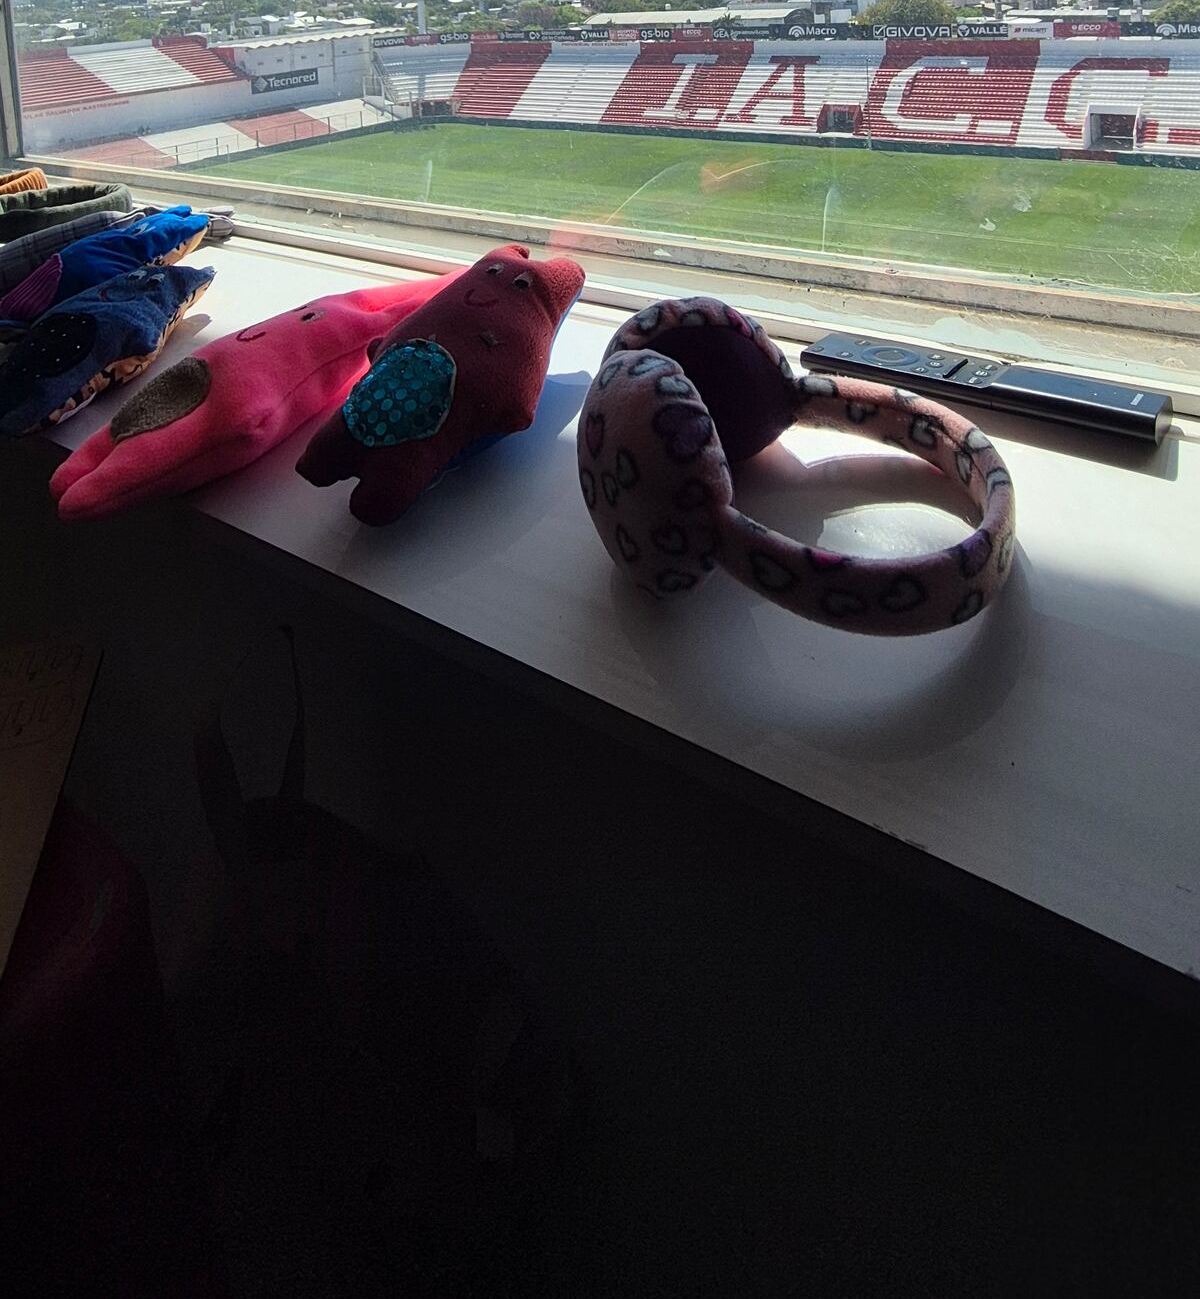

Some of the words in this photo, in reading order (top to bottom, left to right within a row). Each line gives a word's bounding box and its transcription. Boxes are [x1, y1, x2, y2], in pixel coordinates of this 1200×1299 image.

[806, 26, 837, 36] Macro
[886, 26, 950, 37] GIVOVA
[971, 24, 1008, 34] VALLÉ
[374, 37, 405, 47] GIVOVA
[267, 72, 317, 88] Tecnored
